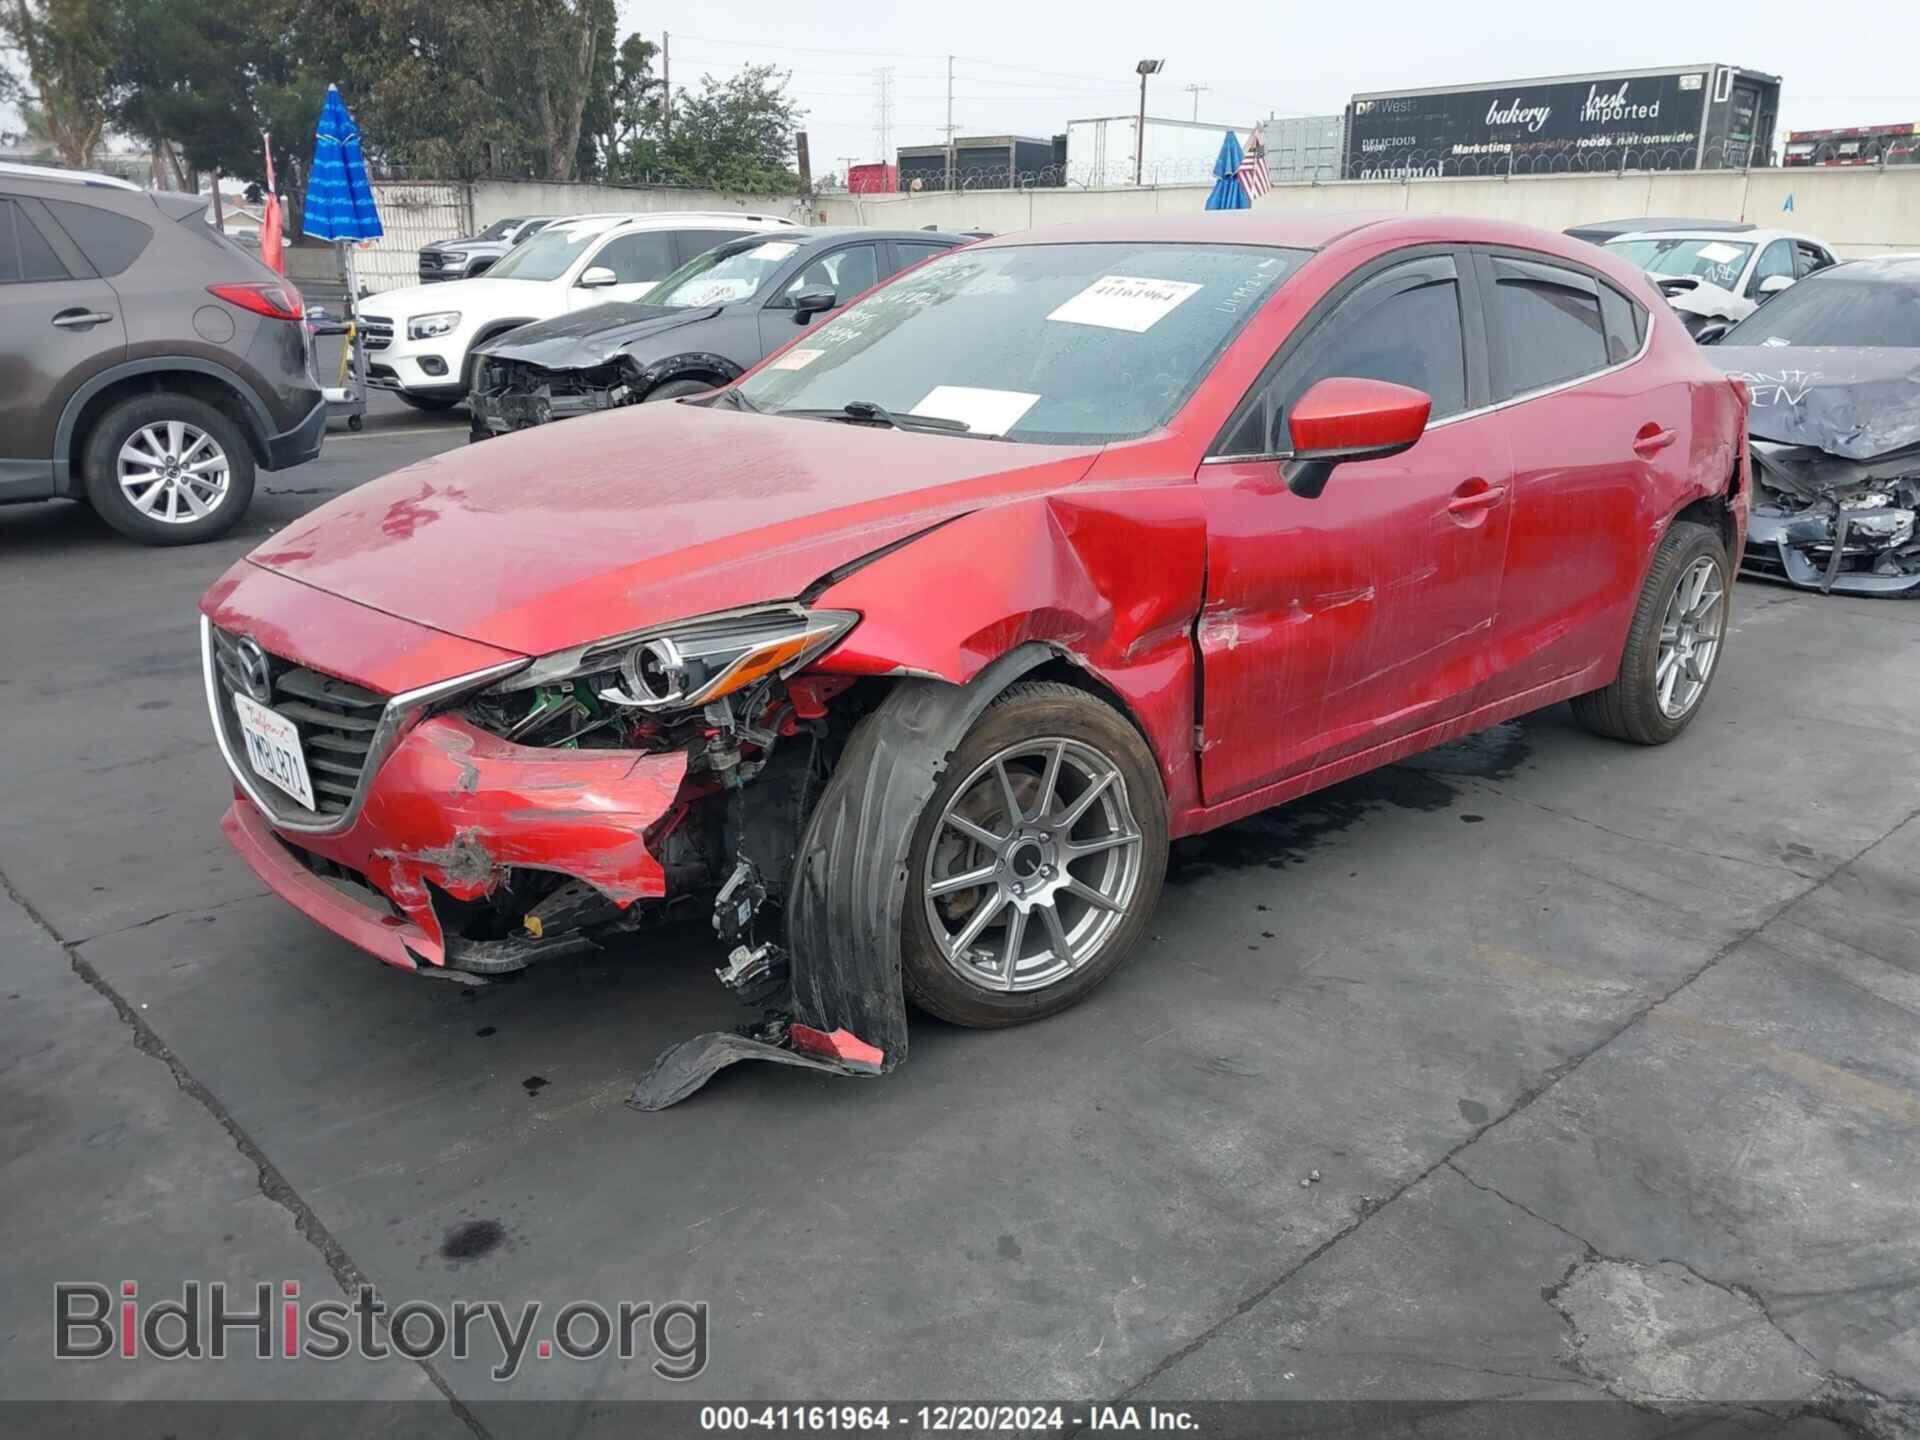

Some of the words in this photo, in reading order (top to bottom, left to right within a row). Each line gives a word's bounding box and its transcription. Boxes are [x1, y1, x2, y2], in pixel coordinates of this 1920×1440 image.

[1485, 98, 1551, 133] bakery
[1580, 100, 1660, 124] imported
[1452, 142, 1512, 154] Marketing
[1616, 131, 1697, 146] nationwide
